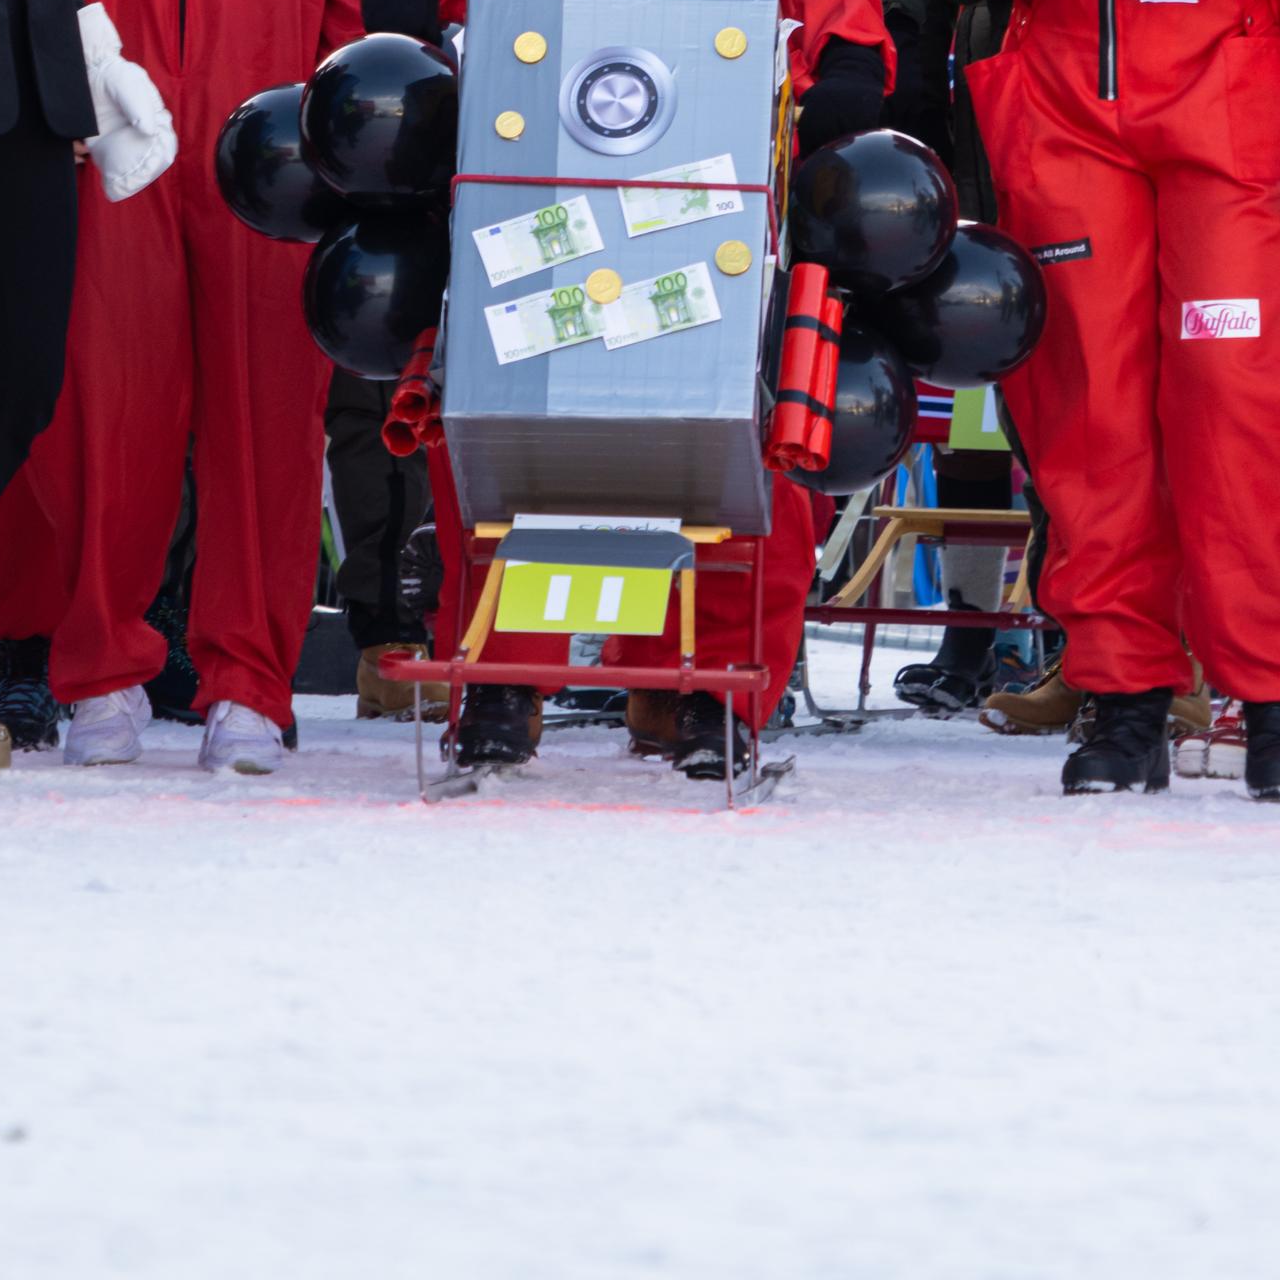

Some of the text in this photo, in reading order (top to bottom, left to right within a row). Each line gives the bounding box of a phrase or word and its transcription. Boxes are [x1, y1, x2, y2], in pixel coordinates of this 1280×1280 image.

[535, 205, 569, 226] 100
[715, 200, 735, 212] 100
[654, 272, 688, 294] 100
[551, 286, 585, 308] 100
[1184, 307, 1258, 337] Buffalo
